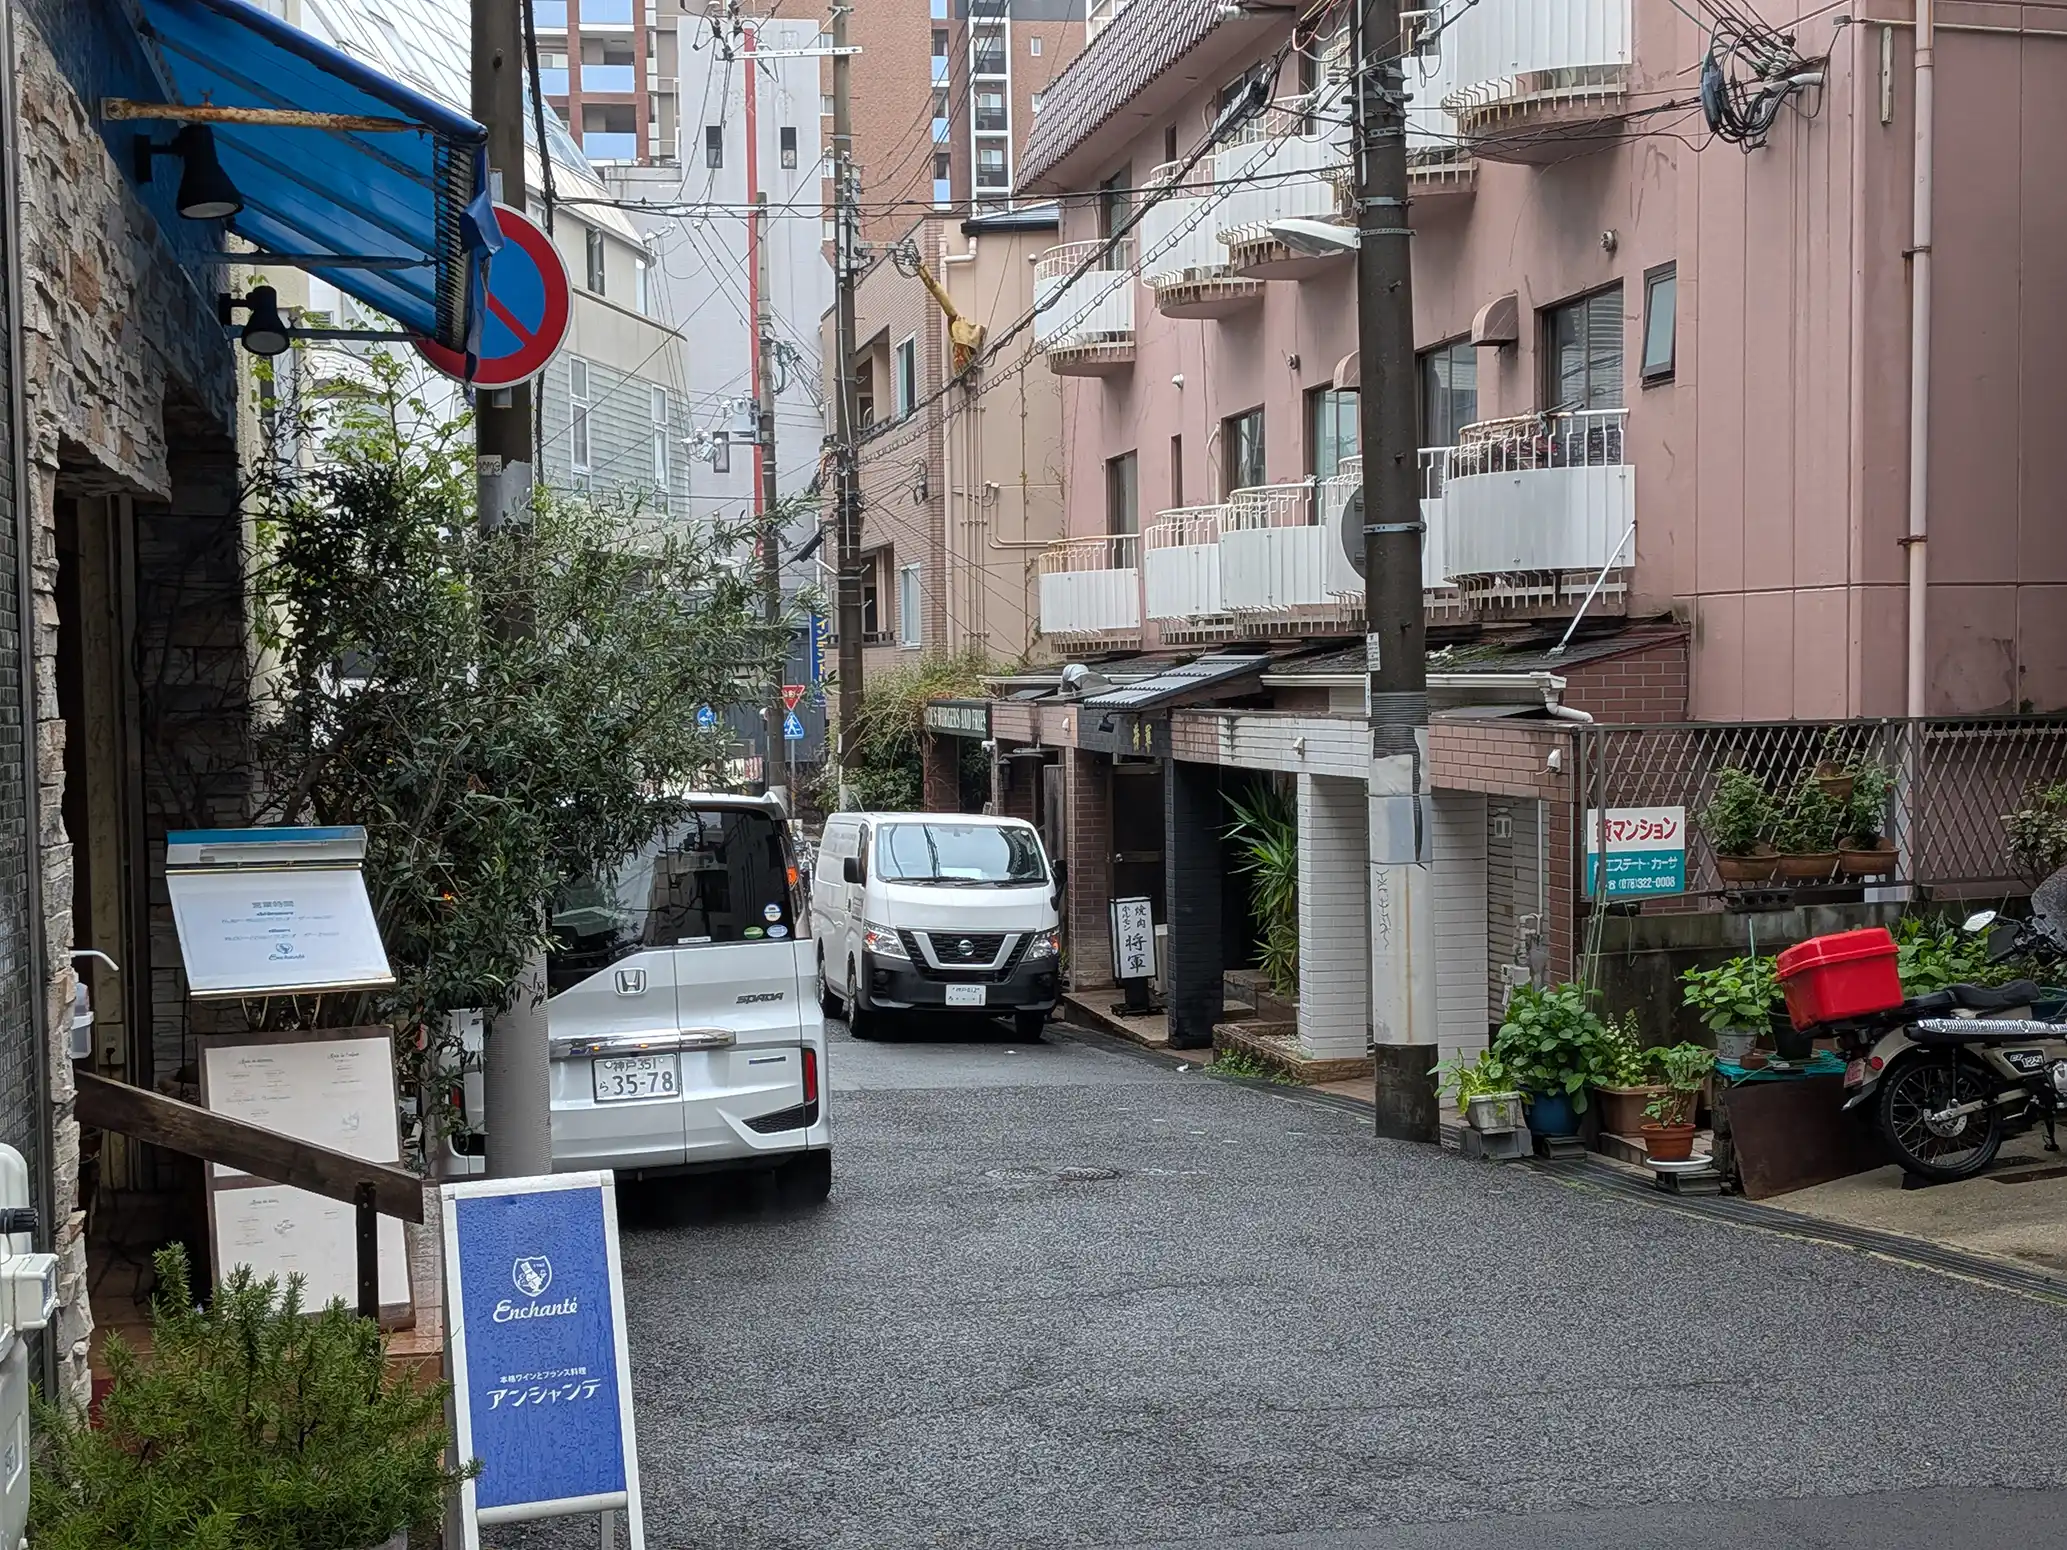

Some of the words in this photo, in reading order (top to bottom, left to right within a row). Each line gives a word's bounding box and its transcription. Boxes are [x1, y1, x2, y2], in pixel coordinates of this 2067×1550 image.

[1121, 905, 1132, 932] ホルモン
[1134, 904, 1147, 929] 焼肉
[1125, 932, 1148, 974] 将軍
[736, 992, 785, 1005] SPADA
[599, 1080, 609, 1093] ら
[611, 1070, 674, 1096] 35-78
[492, 1295, 579, 1323] Enchanté
[499, 1366, 587, 1384] 本格ワインとフランス料理
[486, 1378, 602, 1411] アンシャンテ
